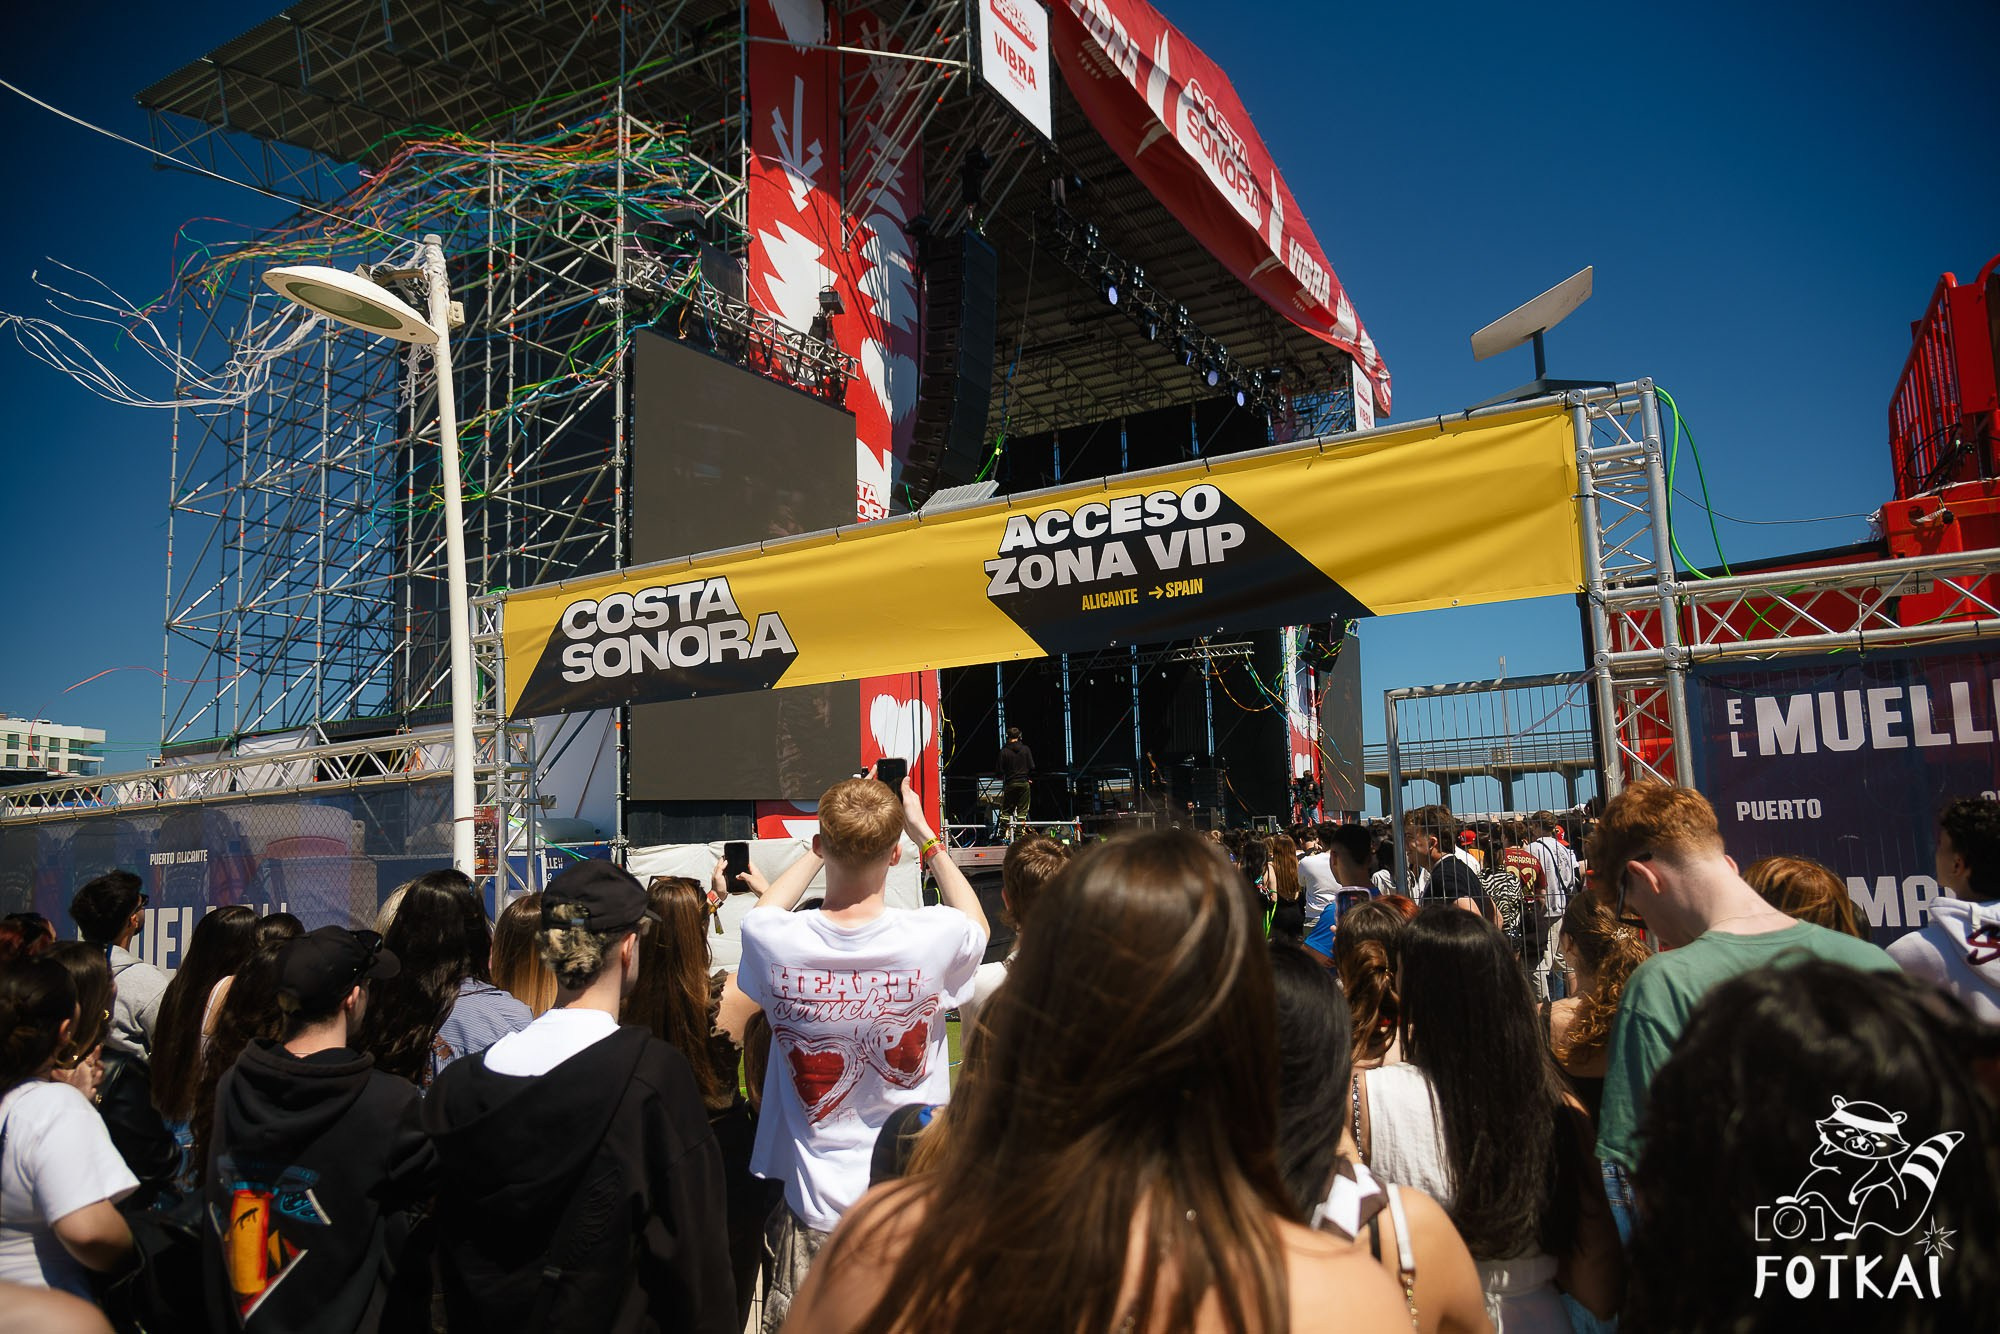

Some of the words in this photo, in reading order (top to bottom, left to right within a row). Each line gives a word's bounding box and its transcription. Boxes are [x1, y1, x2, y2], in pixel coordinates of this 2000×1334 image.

[994, 31, 1037, 90] VIBRA
[1190, 81, 1251, 172] COSTA
[1187, 108, 1262, 218] SONORA
[1289, 236, 1331, 309] VIBRA
[999, 484, 1221, 553] ACCESO
[984, 540, 1138, 597] ZONA
[1144, 522, 1246, 571] VIP
[562, 577, 740, 640] COSTA
[1081, 588, 1139, 611] ALICANTE
[1165, 578, 1203, 598] SPAIN
[562, 612, 797, 683] SONORA
[1754, 678, 2000, 756] MUELL
[1736, 798, 1822, 821] PUERTO
[150, 852, 175, 866] PUERTO
[177, 849, 208, 864] ALICANTE
[1846, 875, 1957, 927] MA
[771, 964, 921, 1003] HEART
[773, 989, 889, 1023] struck
